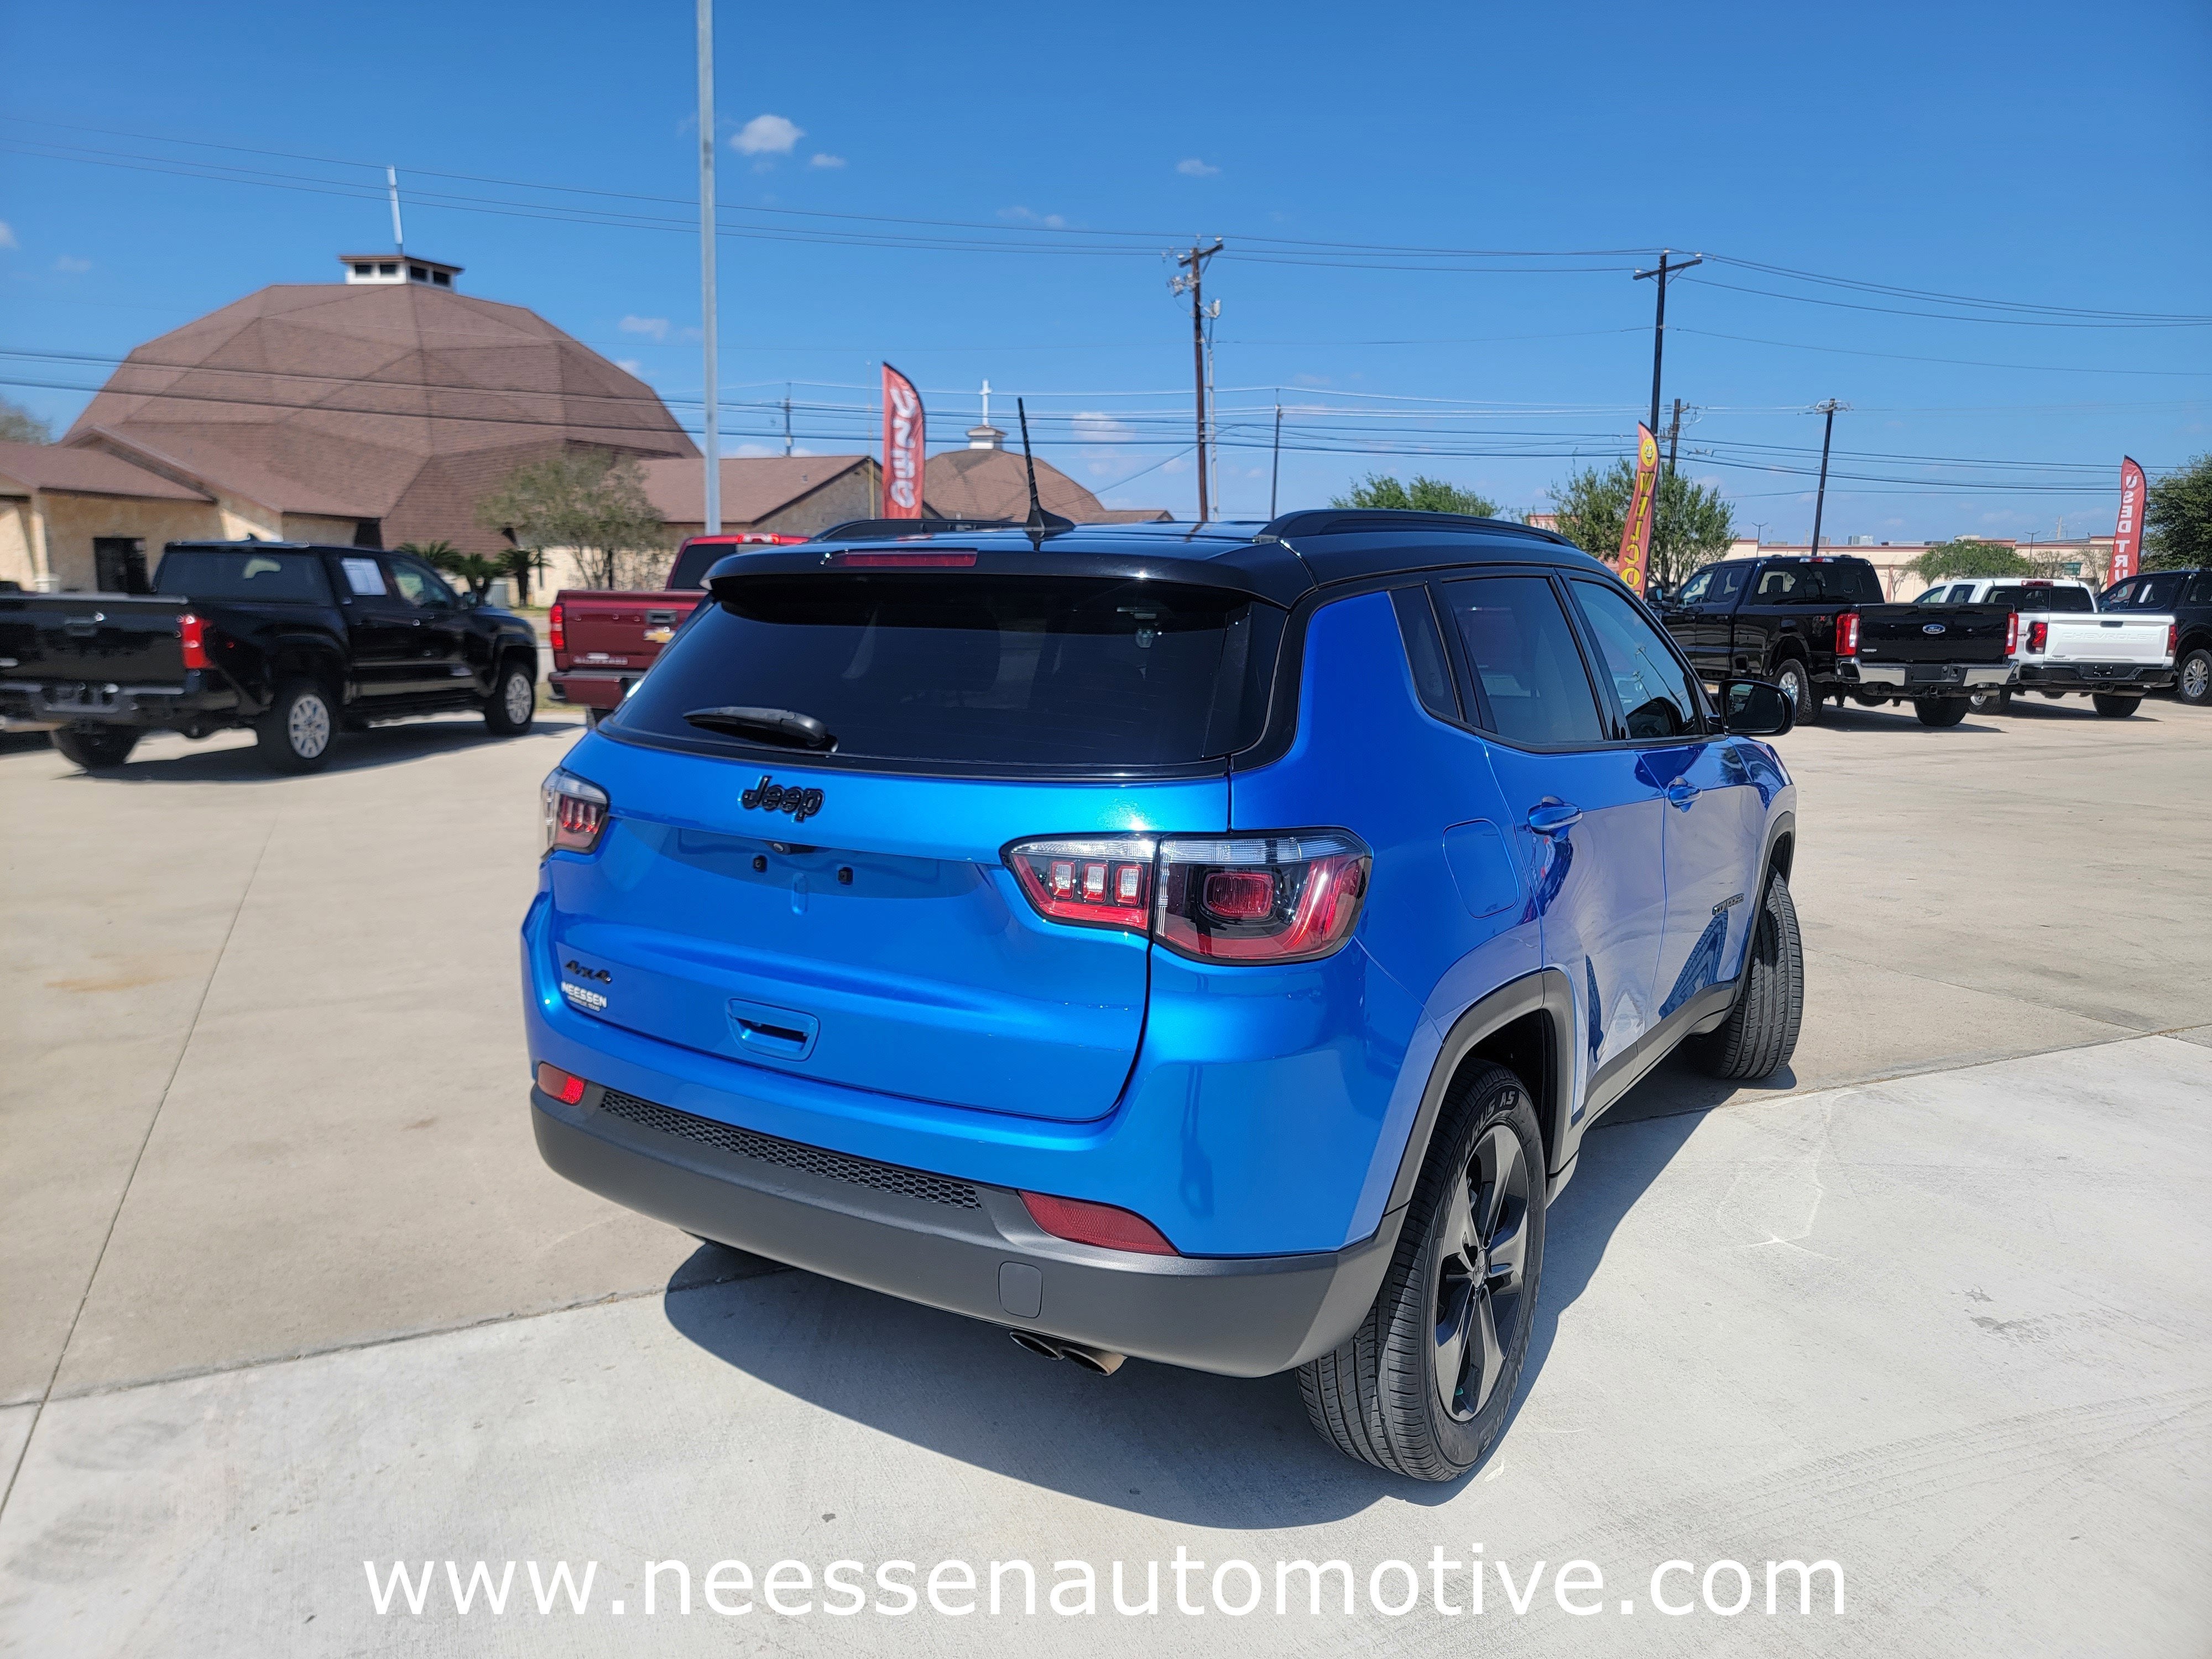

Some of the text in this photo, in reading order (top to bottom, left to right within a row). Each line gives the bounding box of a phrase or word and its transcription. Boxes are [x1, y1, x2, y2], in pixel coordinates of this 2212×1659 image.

[2062, 632, 2158, 641] CHEVROLET
[740, 775, 826, 823] Jeep
[561, 980, 607, 1008] NEESSEN
[1499, 1091, 1516, 1108] AS
